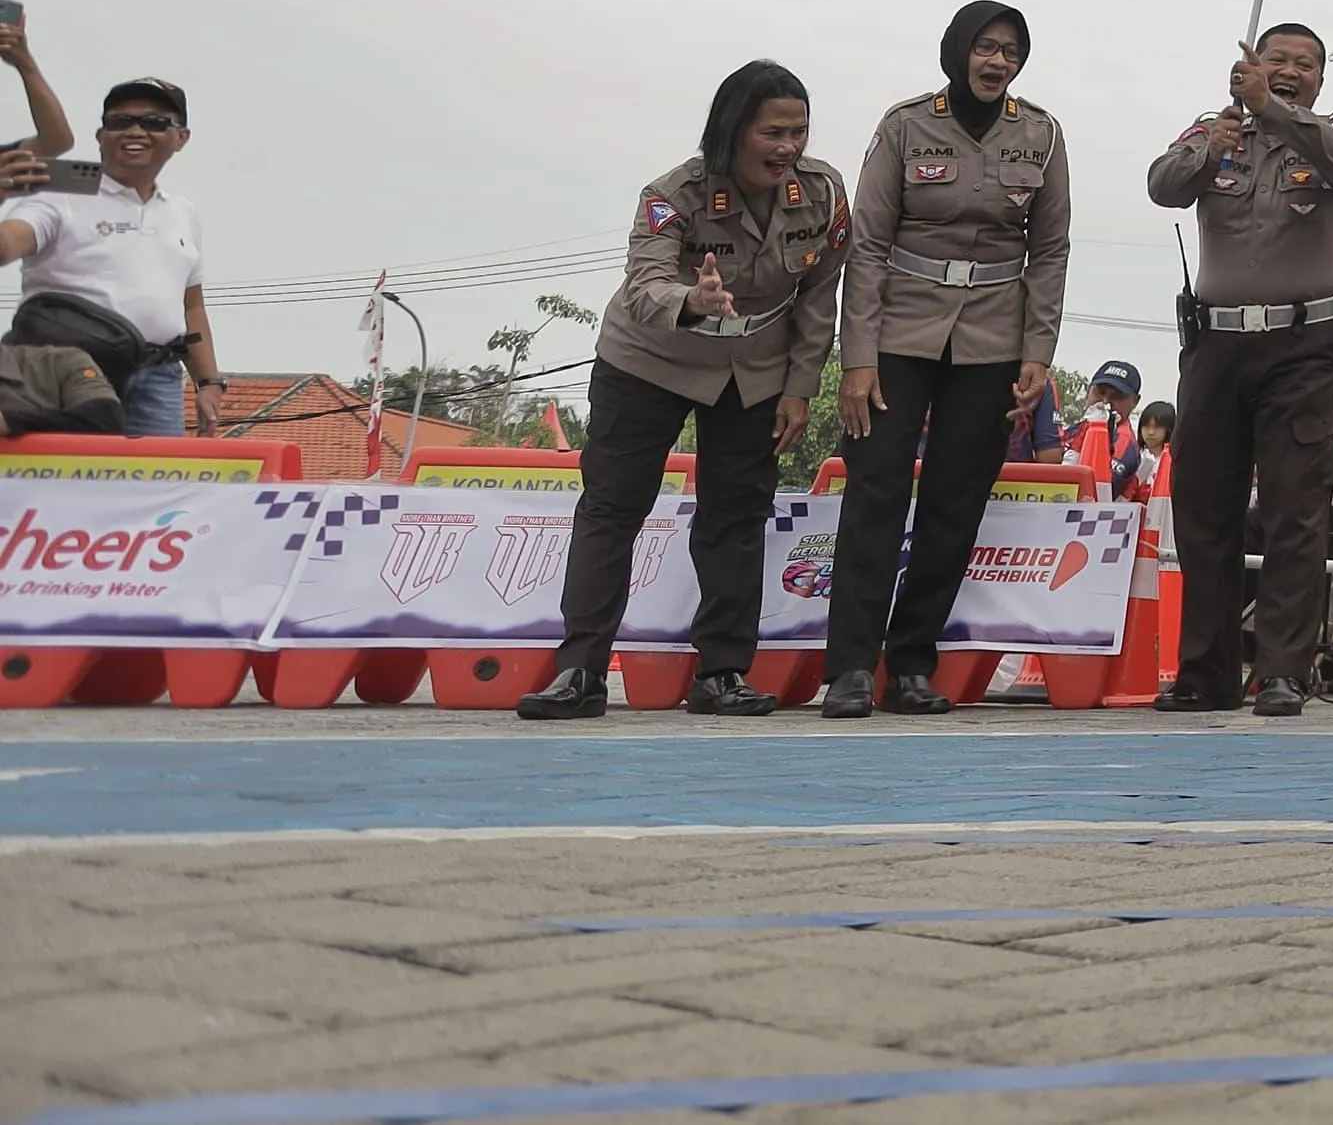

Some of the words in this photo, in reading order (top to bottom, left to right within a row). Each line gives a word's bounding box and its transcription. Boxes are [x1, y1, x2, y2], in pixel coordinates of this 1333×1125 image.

[911, 147, 954, 158] SAMI
[1000, 148, 1047, 164] POLRI
[401, 514, 422, 523] MORE
[423, 514, 444, 524] THAN
[444, 514, 475, 524] BROTHER
[505, 516, 525, 525] MORE
[525, 516, 544, 526] THAN
[18, 580, 103, 599] Drinking
[107, 582, 168, 598] Water
